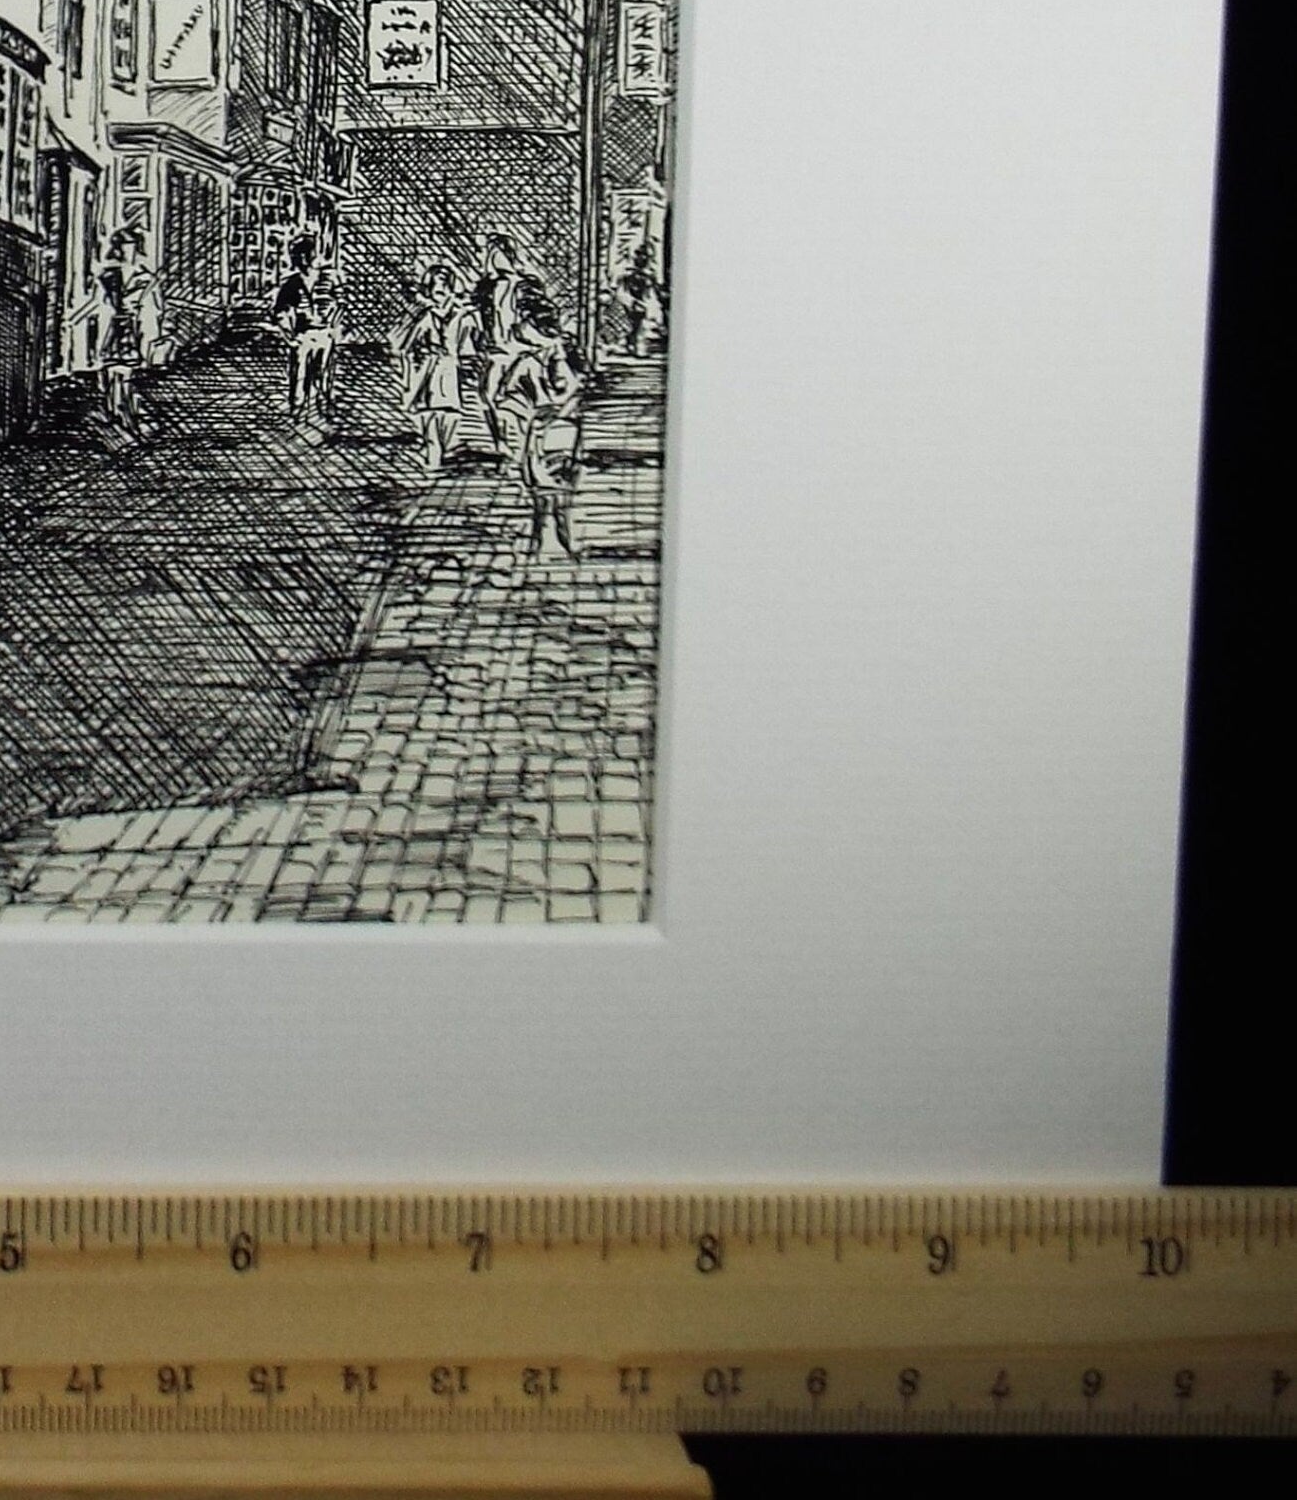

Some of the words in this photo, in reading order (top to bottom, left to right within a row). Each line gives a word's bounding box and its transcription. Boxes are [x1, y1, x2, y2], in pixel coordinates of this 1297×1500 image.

[229, 1232, 254, 1272] 6
[463, 1232, 486, 1273] 7
[695, 1233, 720, 1274] 8
[927, 1234, 950, 1275] 9
[1139, 1237, 1183, 1277] 10
[65, 1364, 103, 1394] 17
[157, 1364, 195, 1394] 16
[248, 1365, 287, 1395] 15
[342, 1365, 379, 1394] 14
[430, 1365, 470, 1395] 13
[521, 1365, 561, 1396] 12
[618, 1365, 652, 1396] 11
[703, 1365, 742, 1396] 10
[807, 1367, 828, 1396] 9
[898, 1367, 919, 1396] 8
[990, 1367, 1011, 1397] 7
[1082, 1367, 1103, 1397] 6
[1174, 1368, 1194, 1398] 5
[1270, 1369, 1292, 1397] 4
